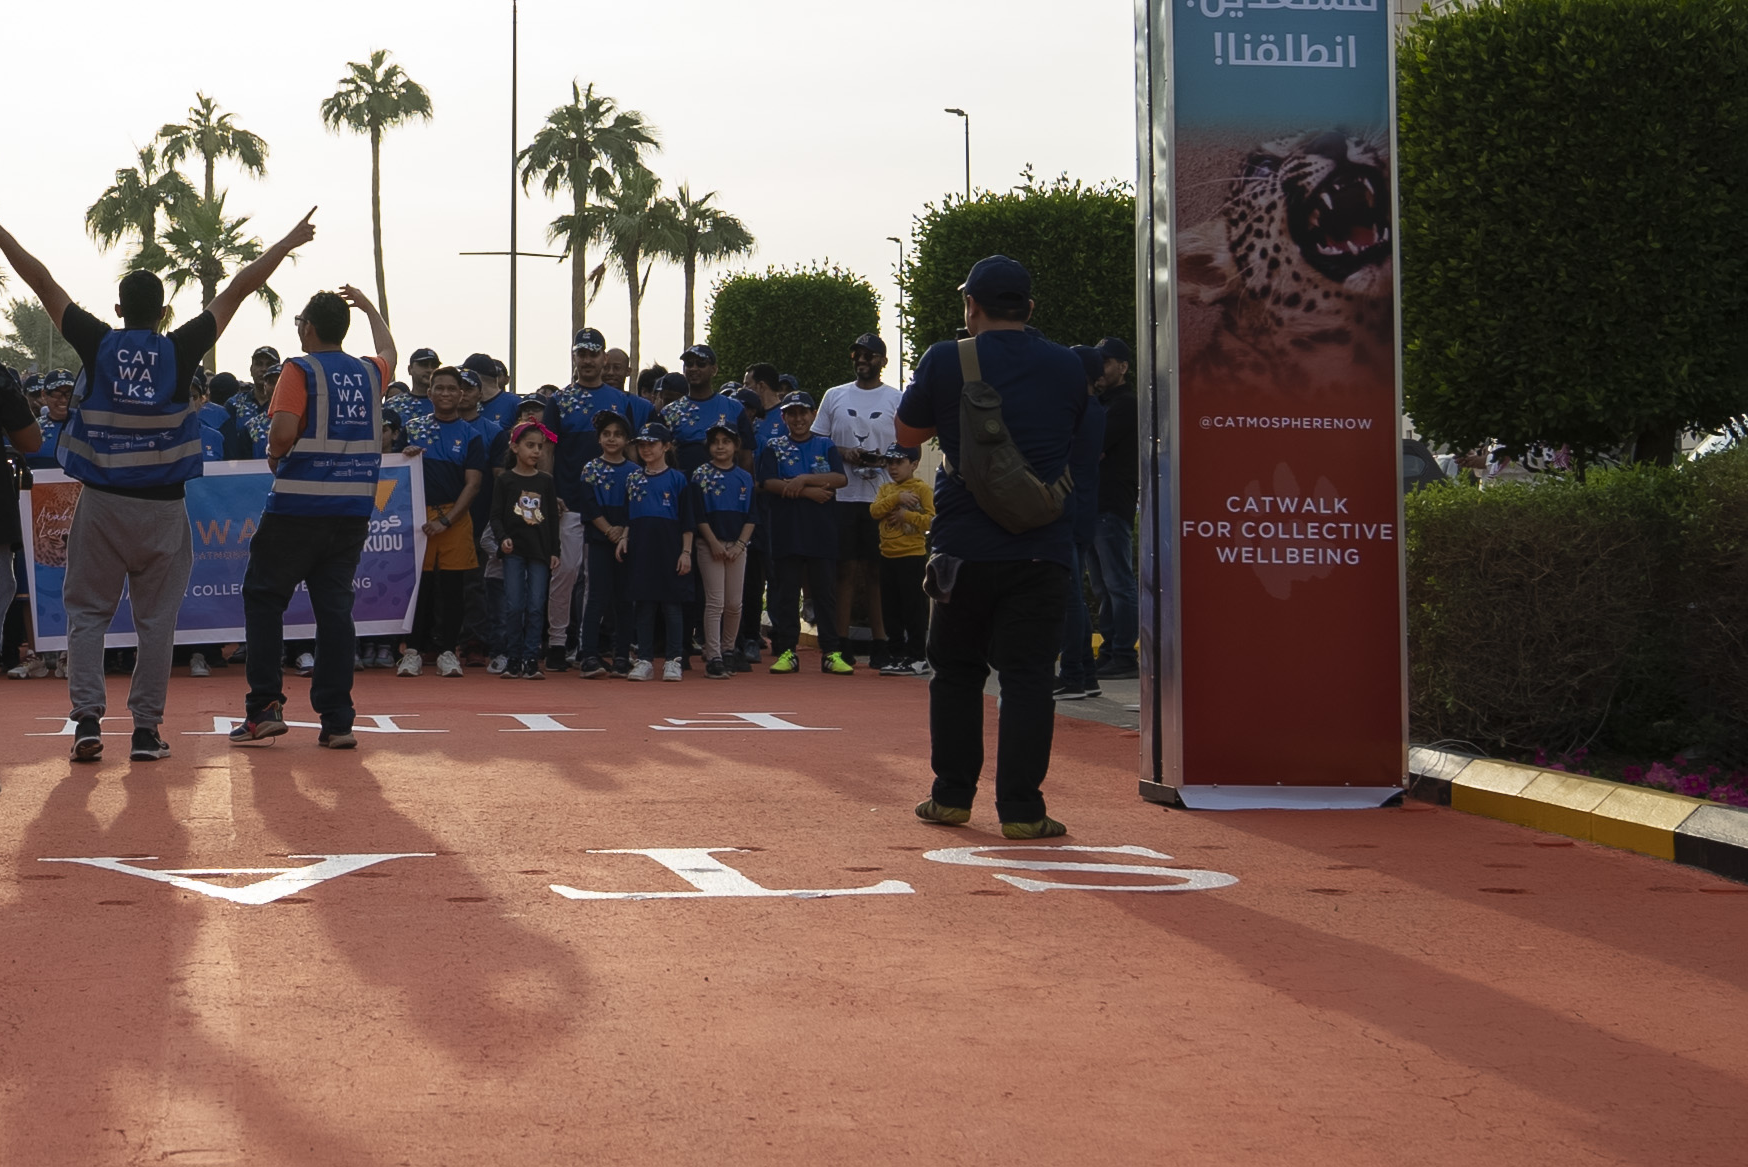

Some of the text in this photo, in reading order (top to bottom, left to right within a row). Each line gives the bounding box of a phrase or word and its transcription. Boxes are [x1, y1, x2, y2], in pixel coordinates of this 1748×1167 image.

[1214, 32, 1356, 69] انطلقنا!
[117, 348, 158, 366] CAT
[118, 365, 152, 383] WA
[332, 372, 363, 386] CAT
[113, 381, 140, 398] LK
[337, 388, 364, 402] WA
[336, 404, 358, 418] LK
[1198, 416, 1373, 430] @CATMOSPHERENOW
[1226, 496, 1349, 514] CATWALK
[1182, 521, 1394, 540] FOR COLLECTIVE
[363, 534, 403, 552] KUDU
[1216, 546, 1360, 565] WELLBEING
